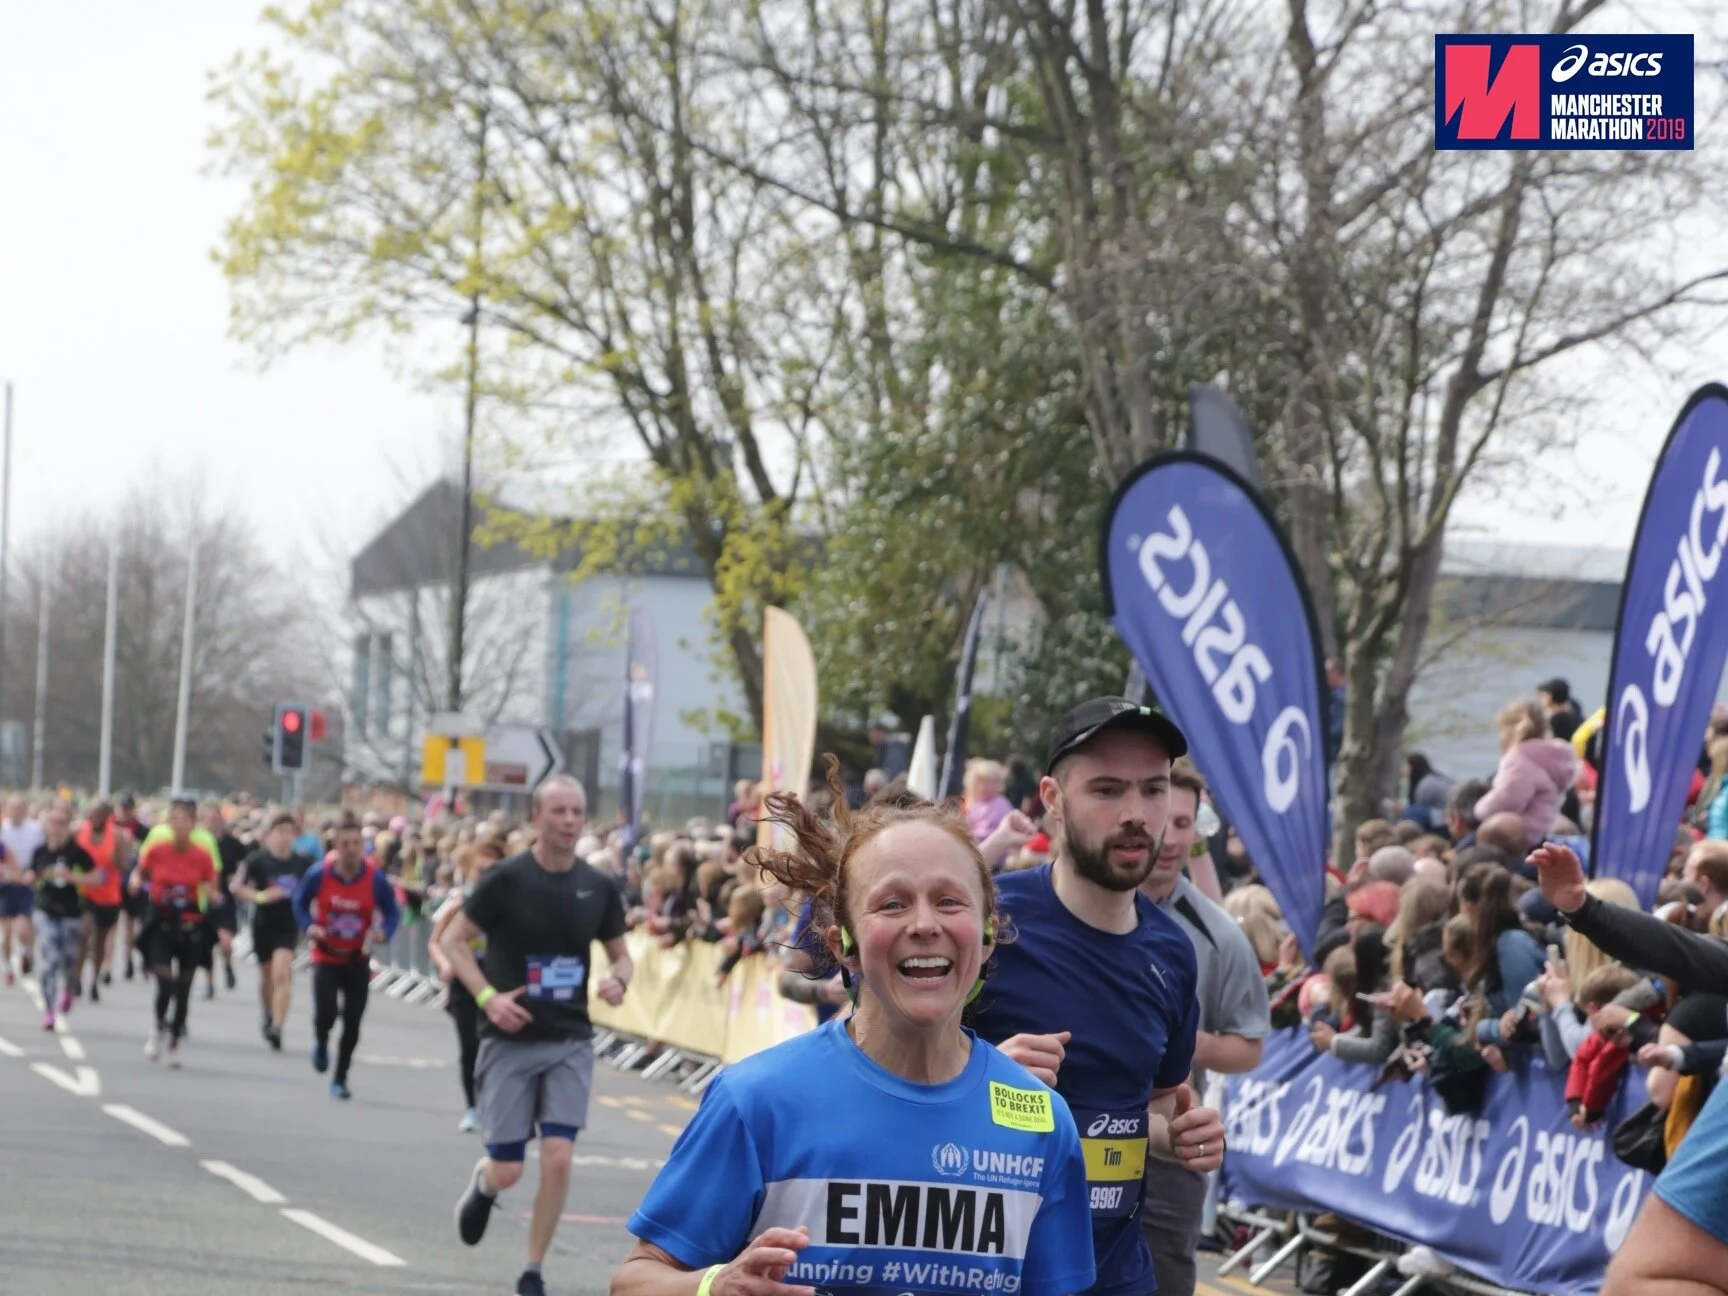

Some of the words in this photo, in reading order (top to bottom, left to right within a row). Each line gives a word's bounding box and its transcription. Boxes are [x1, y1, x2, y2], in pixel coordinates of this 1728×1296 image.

[994, 1086, 1044, 1105] BOLLOCKS
[995, 1096, 1007, 1108] TO
[1009, 1101, 1046, 1115] BREXIT
[1107, 1118, 1140, 1134] asics
[1103, 1147, 1122, 1167] Tim
[972, 1172, 985, 1181] The
[987, 1173, 998, 1183] UN
[1089, 1187, 1123, 1209] 9987
[825, 1182, 1005, 1255] EMMA
[783, 1259, 874, 1285] unning
